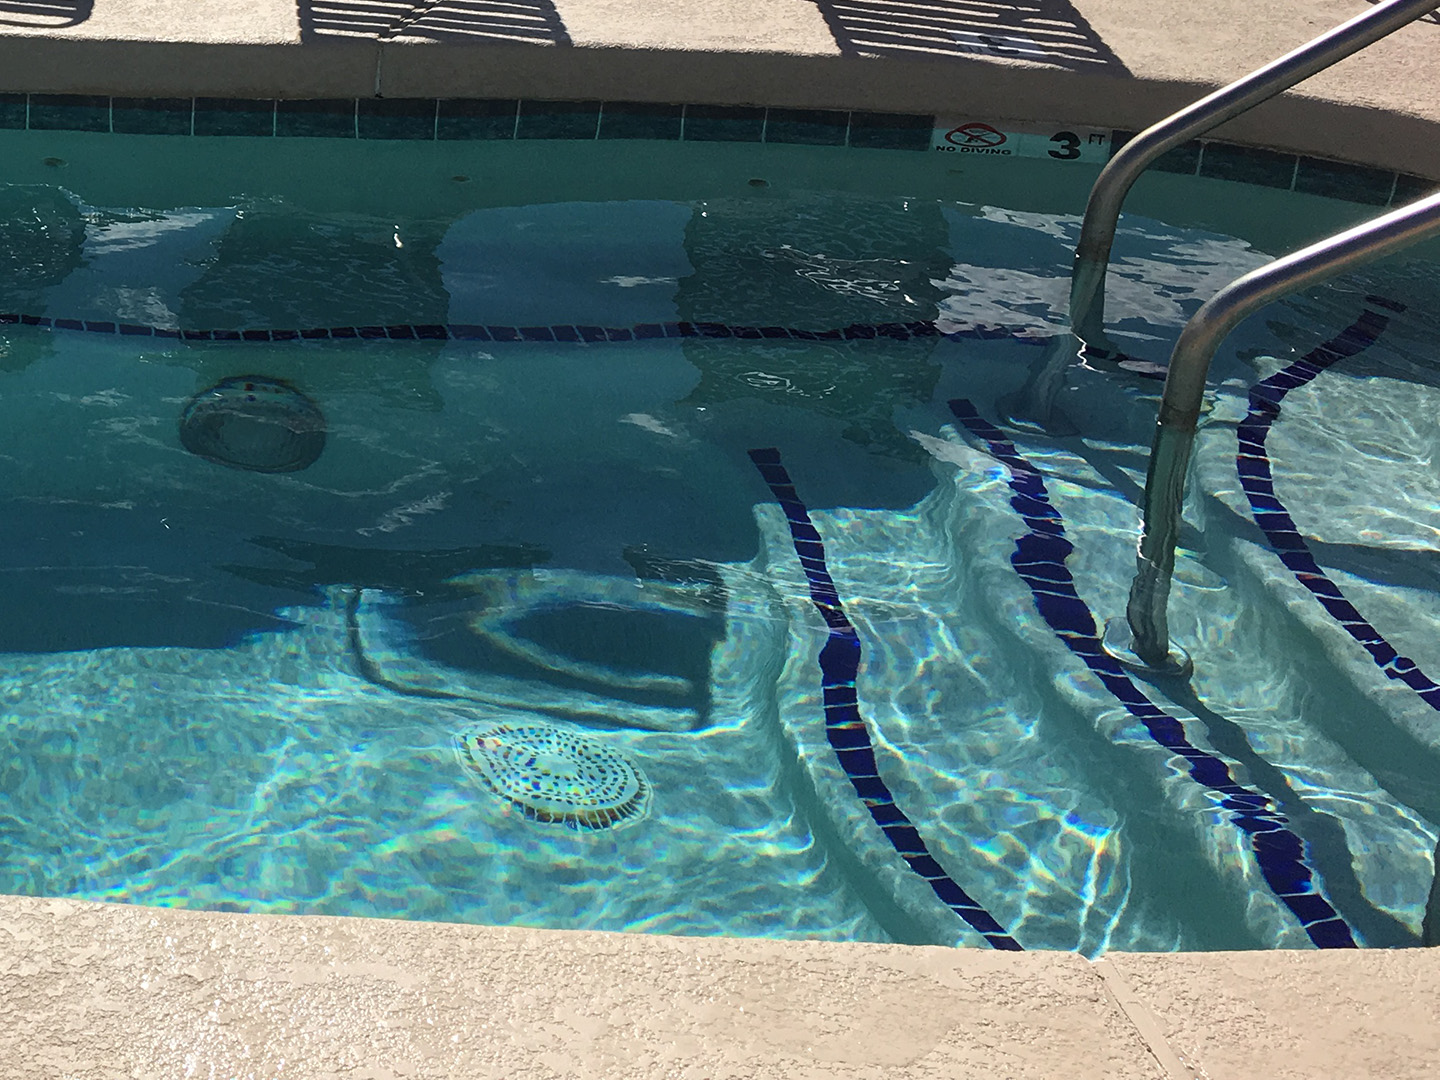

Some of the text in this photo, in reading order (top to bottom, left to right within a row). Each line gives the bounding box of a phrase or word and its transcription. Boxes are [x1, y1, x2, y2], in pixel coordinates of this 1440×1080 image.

[936, 145, 1012, 156] NO DIVING
[1048, 131, 1106, 160] 3 FT
